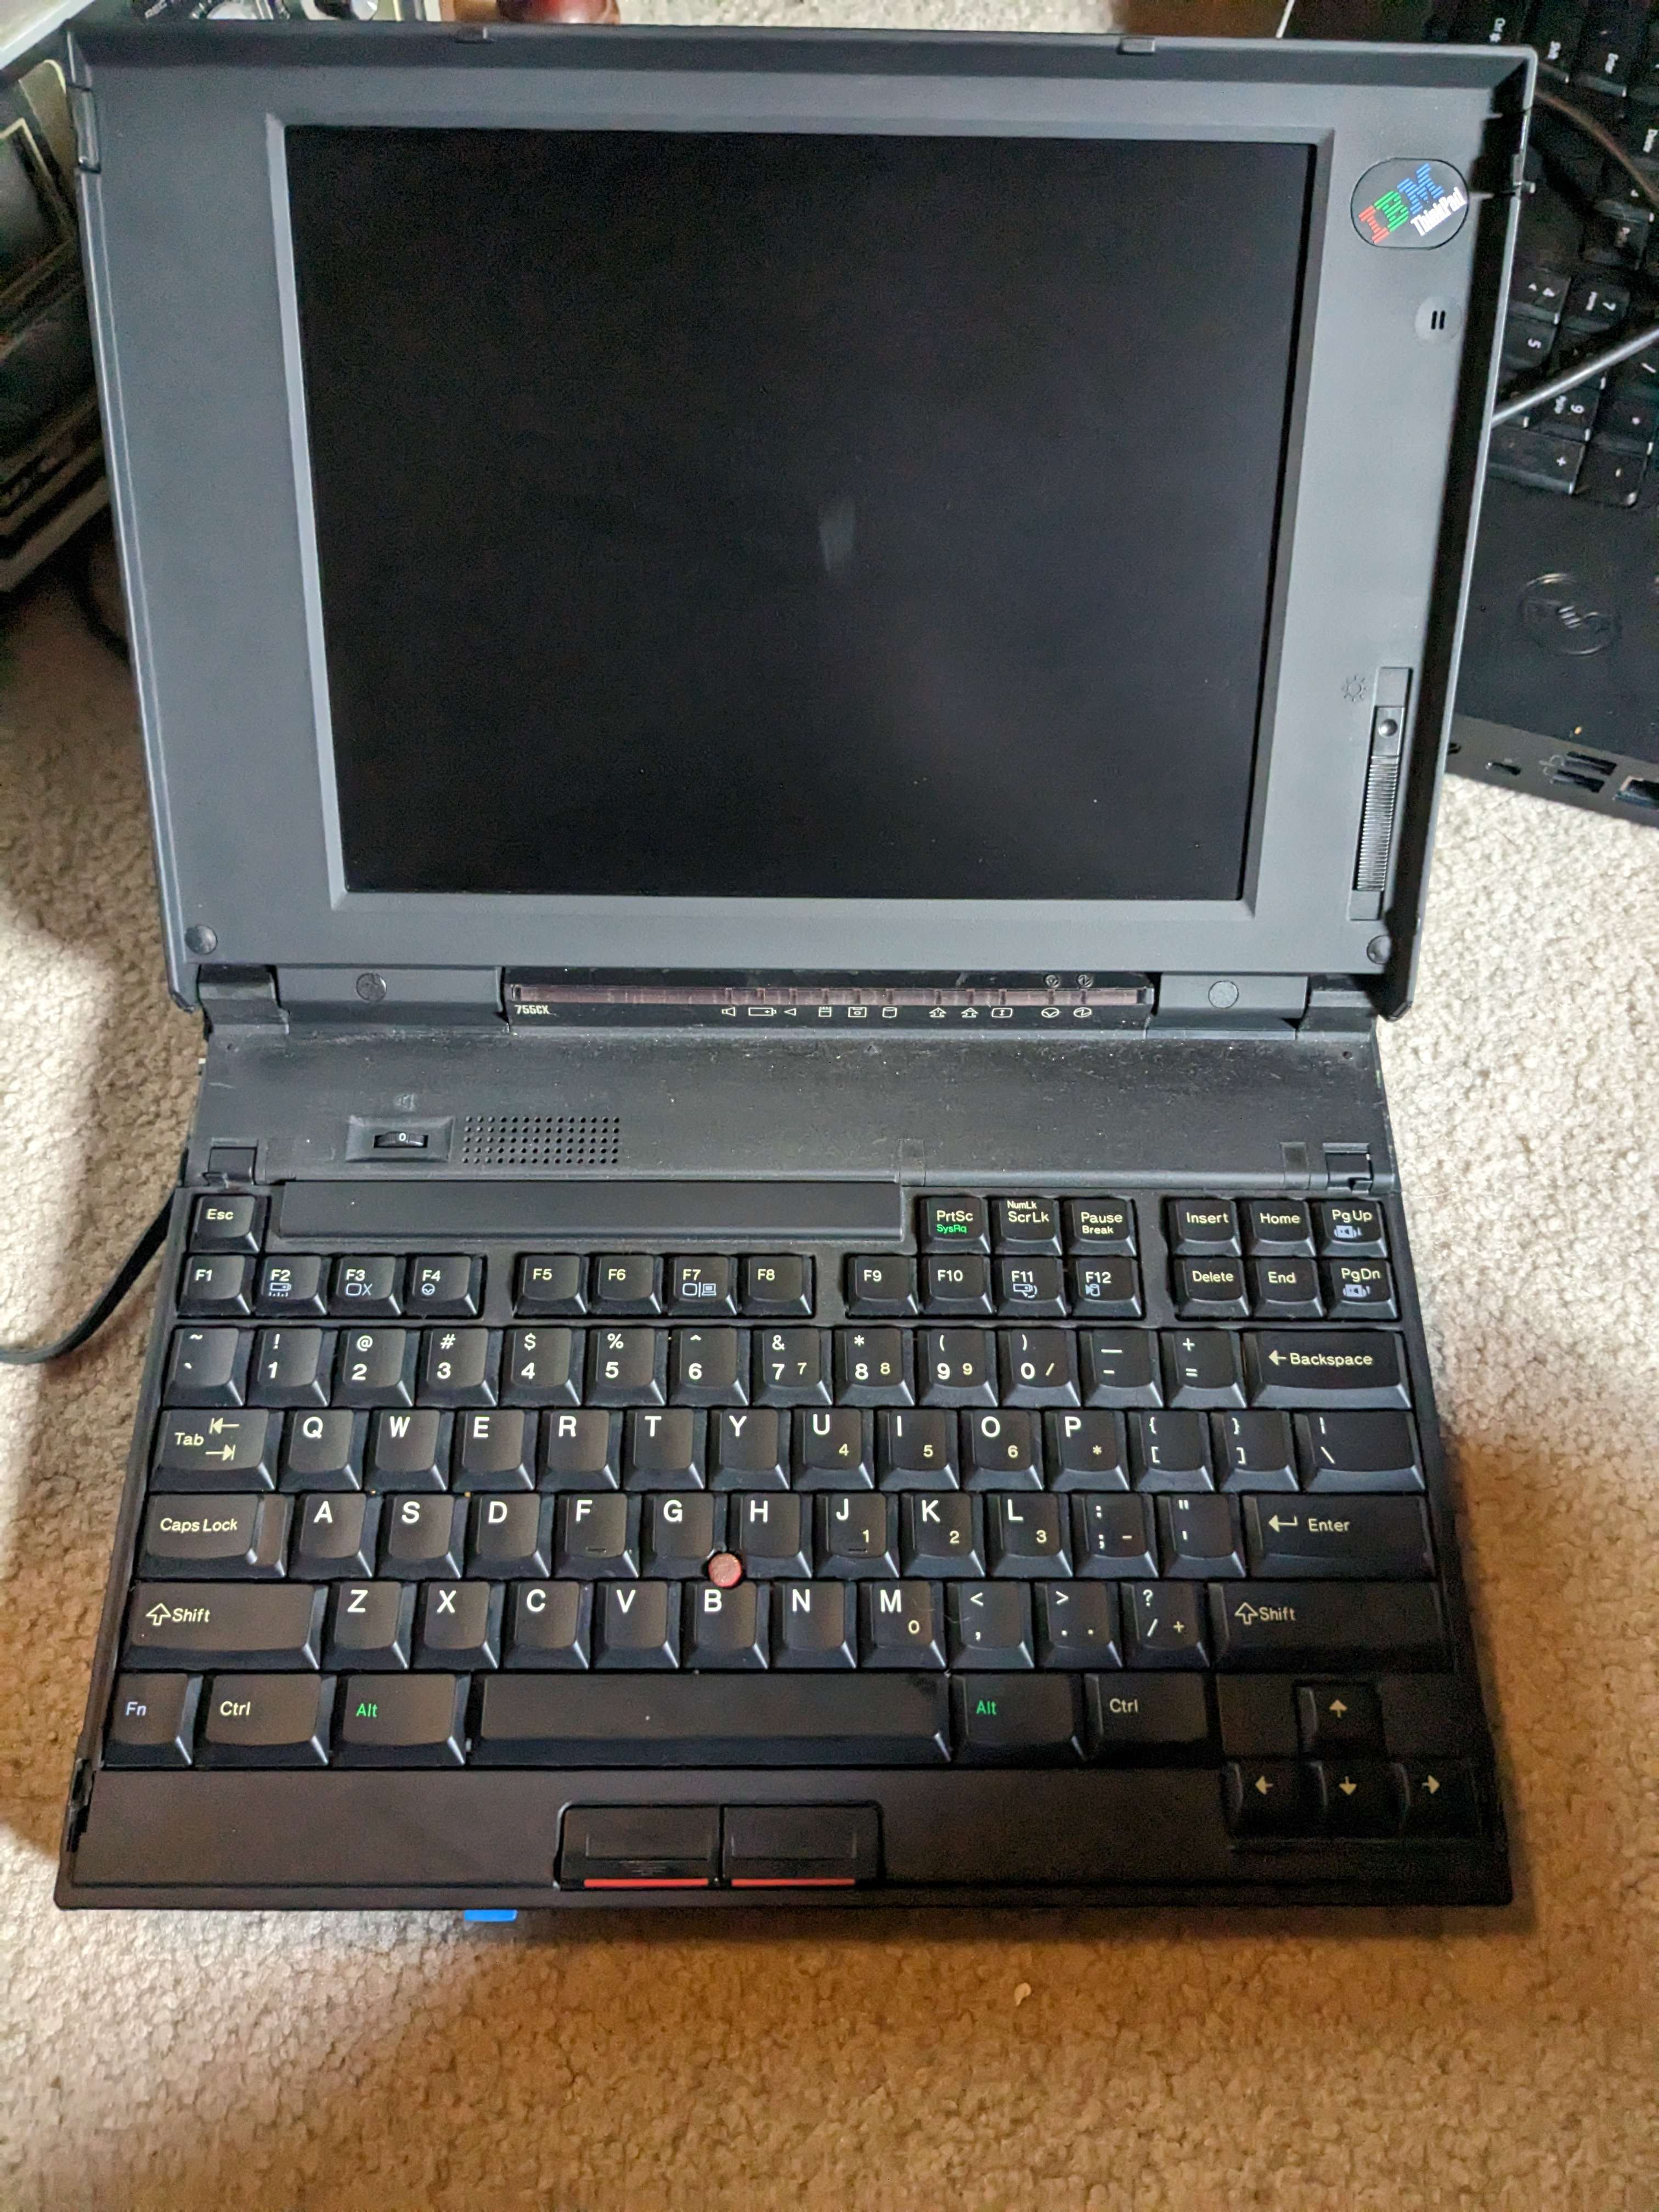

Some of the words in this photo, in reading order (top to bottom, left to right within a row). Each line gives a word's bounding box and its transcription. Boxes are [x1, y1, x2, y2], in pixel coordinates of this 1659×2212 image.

[1358, 163, 1444, 244] IBM
[1410, 187, 1466, 236] ThinkPad
[516, 1004, 551, 1015] 755CX
[1007, 1200, 1037, 1210] NumLk
[206, 1208, 234, 1220] Esc
[936, 1210, 973, 1222] PrtSc
[1081, 1211, 1123, 1223] Pause
[1186, 1212, 1229, 1224] Insert
[1260, 1212, 1300, 1224] Home
[936, 1223, 967, 1234] SysRq
[1082, 1224, 1114, 1234] Break
[195, 1269, 212, 1282] F1
[270, 1269, 291, 1282] F2
[346, 1268, 365, 1282] F3
[422, 1269, 441, 1282] F4
[533, 1268, 552, 1280] F5
[608, 1268, 626, 1281] F6
[682, 1268, 701, 1281] F7
[758, 1268, 775, 1281] F8
[864, 1269, 882, 1282] F9
[937, 1269, 963, 1282] F10
[1011, 1270, 1033, 1283] F11
[1085, 1271, 1111, 1284] F12
[1192, 1270, 1234, 1283] Delete
[1268, 1271, 1296, 1284] End
[1341, 1267, 1380, 1283] PgDn
[1290, 1352, 1373, 1367] Backspace
[268, 1361, 278, 1379] 1
[351, 1363, 368, 1381] 2
[437, 1362, 451, 1379] 3
[521, 1362, 535, 1380] 4
[605, 1361, 619, 1379] 5
[689, 1363, 702, 1380] 6
[772, 1363, 785, 1380] 7
[797, 1362, 807, 1375] 7
[855, 1363, 869, 1380] 8
[880, 1362, 890, 1375] 8
[937, 1363, 950, 1380] 9
[962, 1363, 973, 1375] 9
[303, 1416, 323, 1439] Q
[390, 1415, 410, 1438] W
[473, 1416, 490, 1438] E
[558, 1415, 577, 1437] R
[645, 1415, 662, 1437] T
[729, 1415, 747, 1437] Y
[812, 1413, 830, 1435] U
[896, 1415, 902, 1437] I
[981, 1416, 1001, 1438] O
[1064, 1416, 1081, 1437] P
[174, 1432, 204, 1446] Tab
[838, 1443, 849, 1456] 4
[923, 1444, 934, 1458] 5
[1008, 1444, 1018, 1458] 6
[313, 1500, 333, 1523] A
[402, 1501, 420, 1524] S
[488, 1501, 507, 1523] D
[575, 1499, 593, 1522] F
[663, 1499, 682, 1522] G
[750, 1500, 768, 1523] H
[836, 1498, 849, 1521] J
[922, 1499, 941, 1522] K
[1007, 1499, 1024, 1521] L
[160, 1517, 200, 1533] Caps
[202, 1518, 238, 1532] Lock
[1308, 1518, 1350, 1532] Enter
[862, 1529, 869, 1543] 1
[950, 1530, 960, 1544] 2
[1036, 1530, 1047, 1543] 3
[347, 1589, 368, 1613] Z
[437, 1590, 457, 1613] X
[526, 1589, 546, 1612] C
[616, 1589, 636, 1613] V
[704, 1589, 722, 1612] B
[792, 1588, 810, 1612] N
[880, 1589, 902, 1612] M
[172, 1607, 210, 1623] Shift
[1259, 1606, 1295, 1621] Shift
[126, 1701, 146, 1716] Fn
[220, 1701, 251, 1716] Ctrl
[356, 1703, 377, 1718] Alt
[976, 1700, 997, 1715] Alt
[1109, 1698, 1138, 1713] Ctrl
